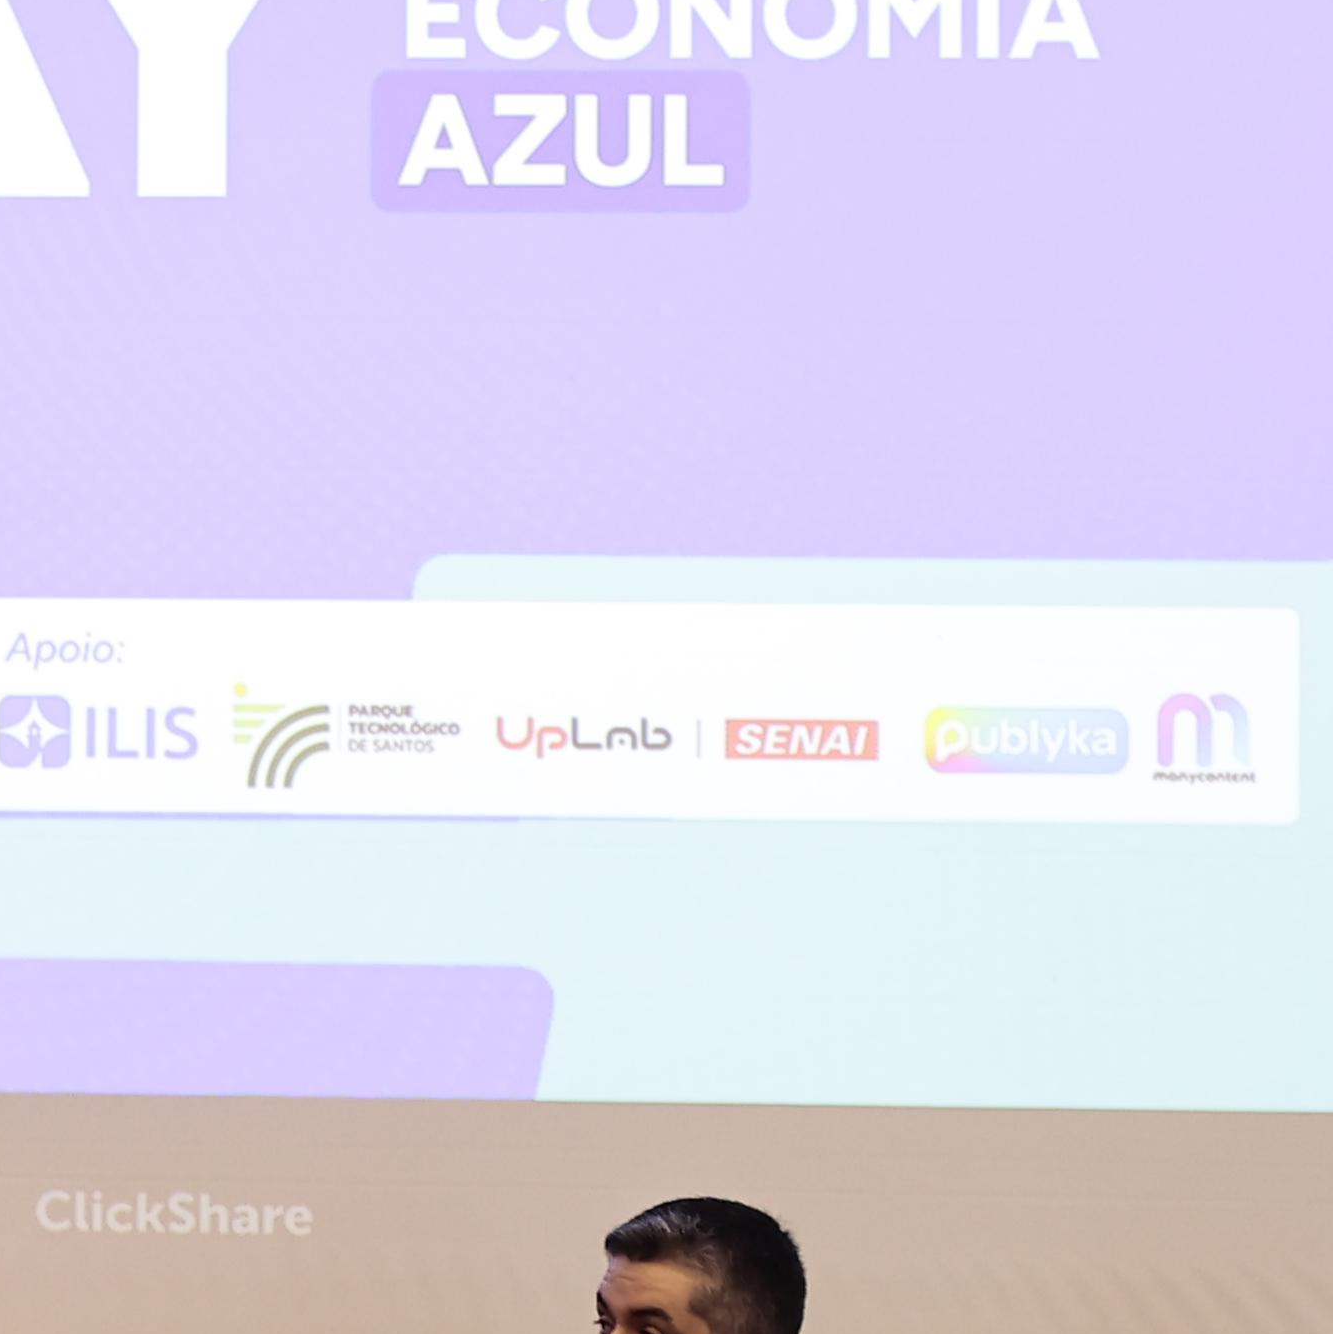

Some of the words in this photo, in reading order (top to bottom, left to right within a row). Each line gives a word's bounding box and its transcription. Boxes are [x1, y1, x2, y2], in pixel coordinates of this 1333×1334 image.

[398, 93, 726, 188] AZUL
[6, 632, 125, 670] Apoio:
[348, 705, 413, 718] PARQUE
[349, 721, 460, 735] TECNOLÓGICO
[85, 706, 199, 760] ILIS
[348, 739, 367, 752] DE
[373, 739, 435, 753] SANTOS
[734, 724, 868, 757] SENAI
[35, 1189, 314, 1237] ClickShare
